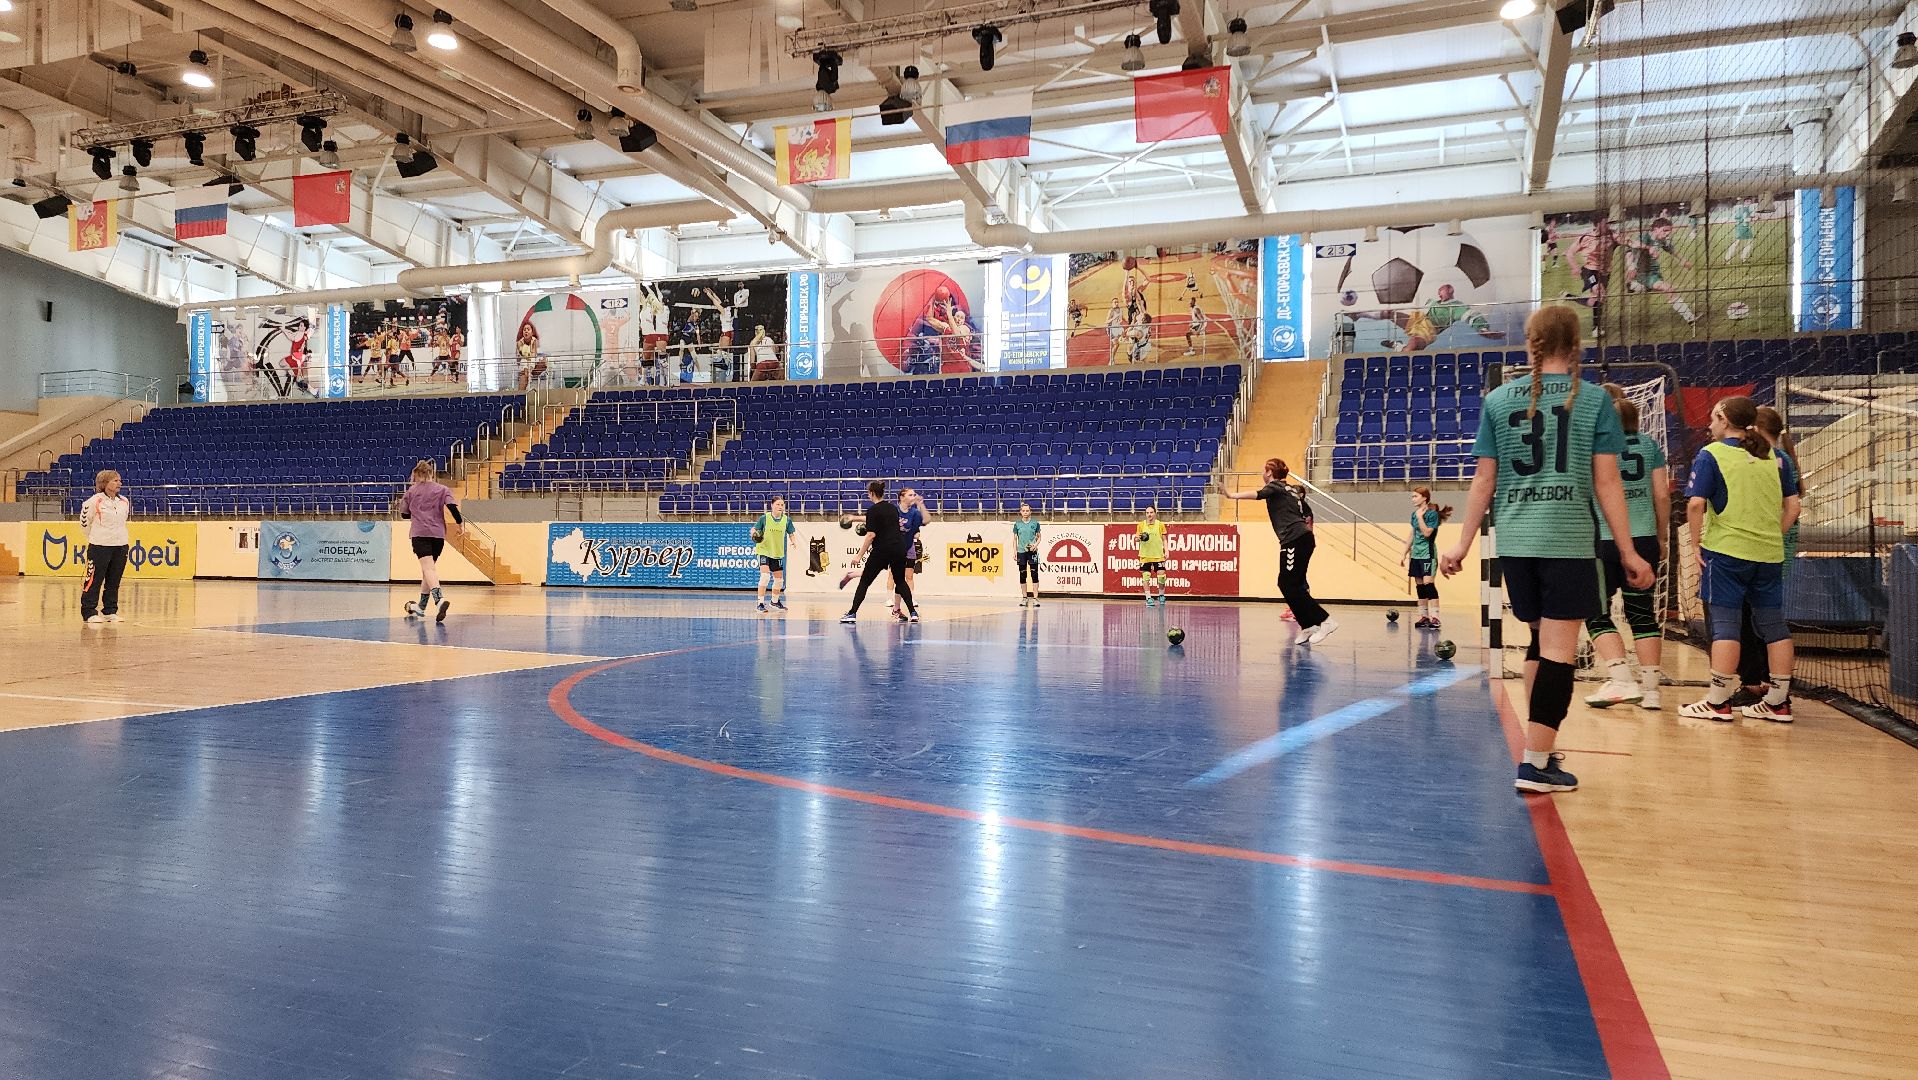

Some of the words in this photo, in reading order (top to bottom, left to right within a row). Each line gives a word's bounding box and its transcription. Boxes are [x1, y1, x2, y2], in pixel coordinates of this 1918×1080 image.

[1327, 247, 1334, 256] 2
[1339, 246, 1345, 254] 3
[1277, 235, 1292, 320] ДС-ЕГОРЬЕВСК.РФ
[1507, 382, 1571, 399] ГРИКОВ
[1508, 405, 1570, 476] 31
[1507, 485, 1574, 503] ЕГОРЬЕВСК
[319, 546, 367, 556] «ПОБЕДА»
[1168, 534, 1236, 552] БАЛКОНЫ
[73, 538, 180, 571] кфей
[580, 539, 694, 577] Курьер
[950, 547, 999, 563] ЮМОР
[697, 559, 760, 569] ПОДМОСКО
[950, 561, 972, 572] FM
[981, 565, 999, 573] 89.7
[1182, 557, 1237, 572] качества!
